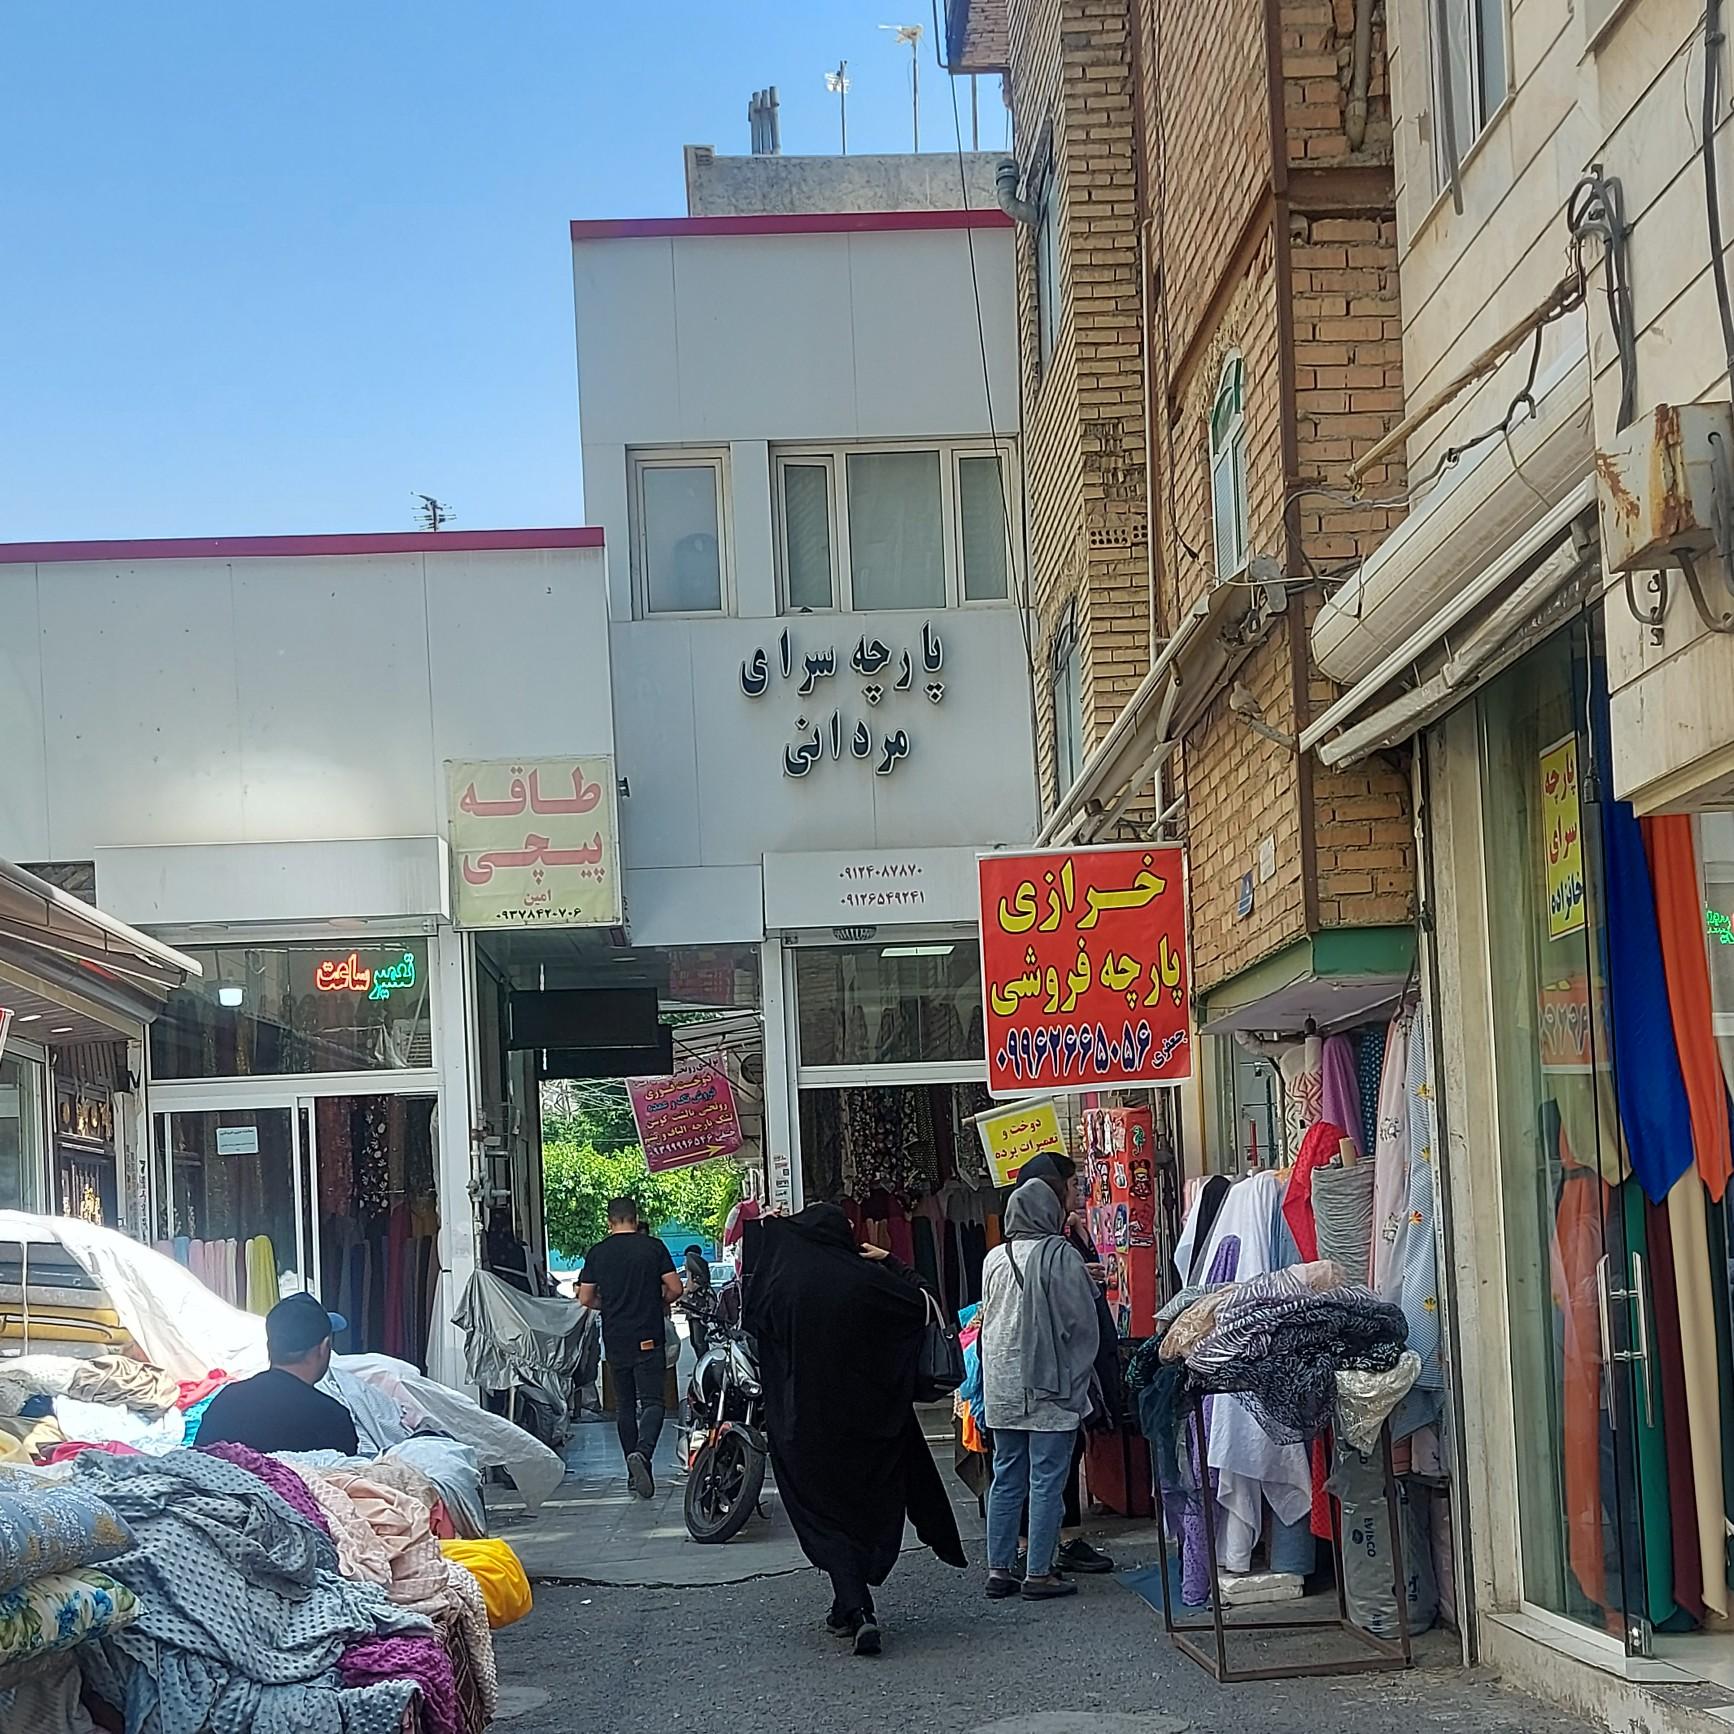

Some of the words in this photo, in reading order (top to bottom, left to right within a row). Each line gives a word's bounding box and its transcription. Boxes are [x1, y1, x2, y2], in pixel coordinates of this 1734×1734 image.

[740, 625, 837, 697] سرای
[850, 619, 945, 705] پارچه
[782, 706, 911, 778] مردانی
[459, 764, 603, 819] طاقه
[1544, 751, 1577, 803] پارچه
[462, 830, 606, 886] پیچی
[1549, 815, 1578, 865] سرای
[839, 863, 923, 880] ۰۹۱۲۴۰۸۷۸۷۰
[998, 852, 1168, 934] خرازی
[523, 888, 552, 906] امین
[840, 890, 925, 907] ۰۹۱۲۶۵۴۹۲۴۱
[316, 952, 371, 991] ساعت
[368, 952, 417, 1000] تعمیر
[990, 936, 1093, 1016] فروشی
[1099, 932, 1184, 1011] پارچه
[996, 1018, 1152, 1081] ۰۹۹۶۲۶۶۵۰۵۶
[1151, 1029, 1188, 1069] جعفری
[1001, 1129, 1008, 1139] و
[1009, 1117, 1042, 1136] دوخت
[1019, 1131, 1059, 1153] تعمیرات
[995, 1146, 1018, 1160] پرده
